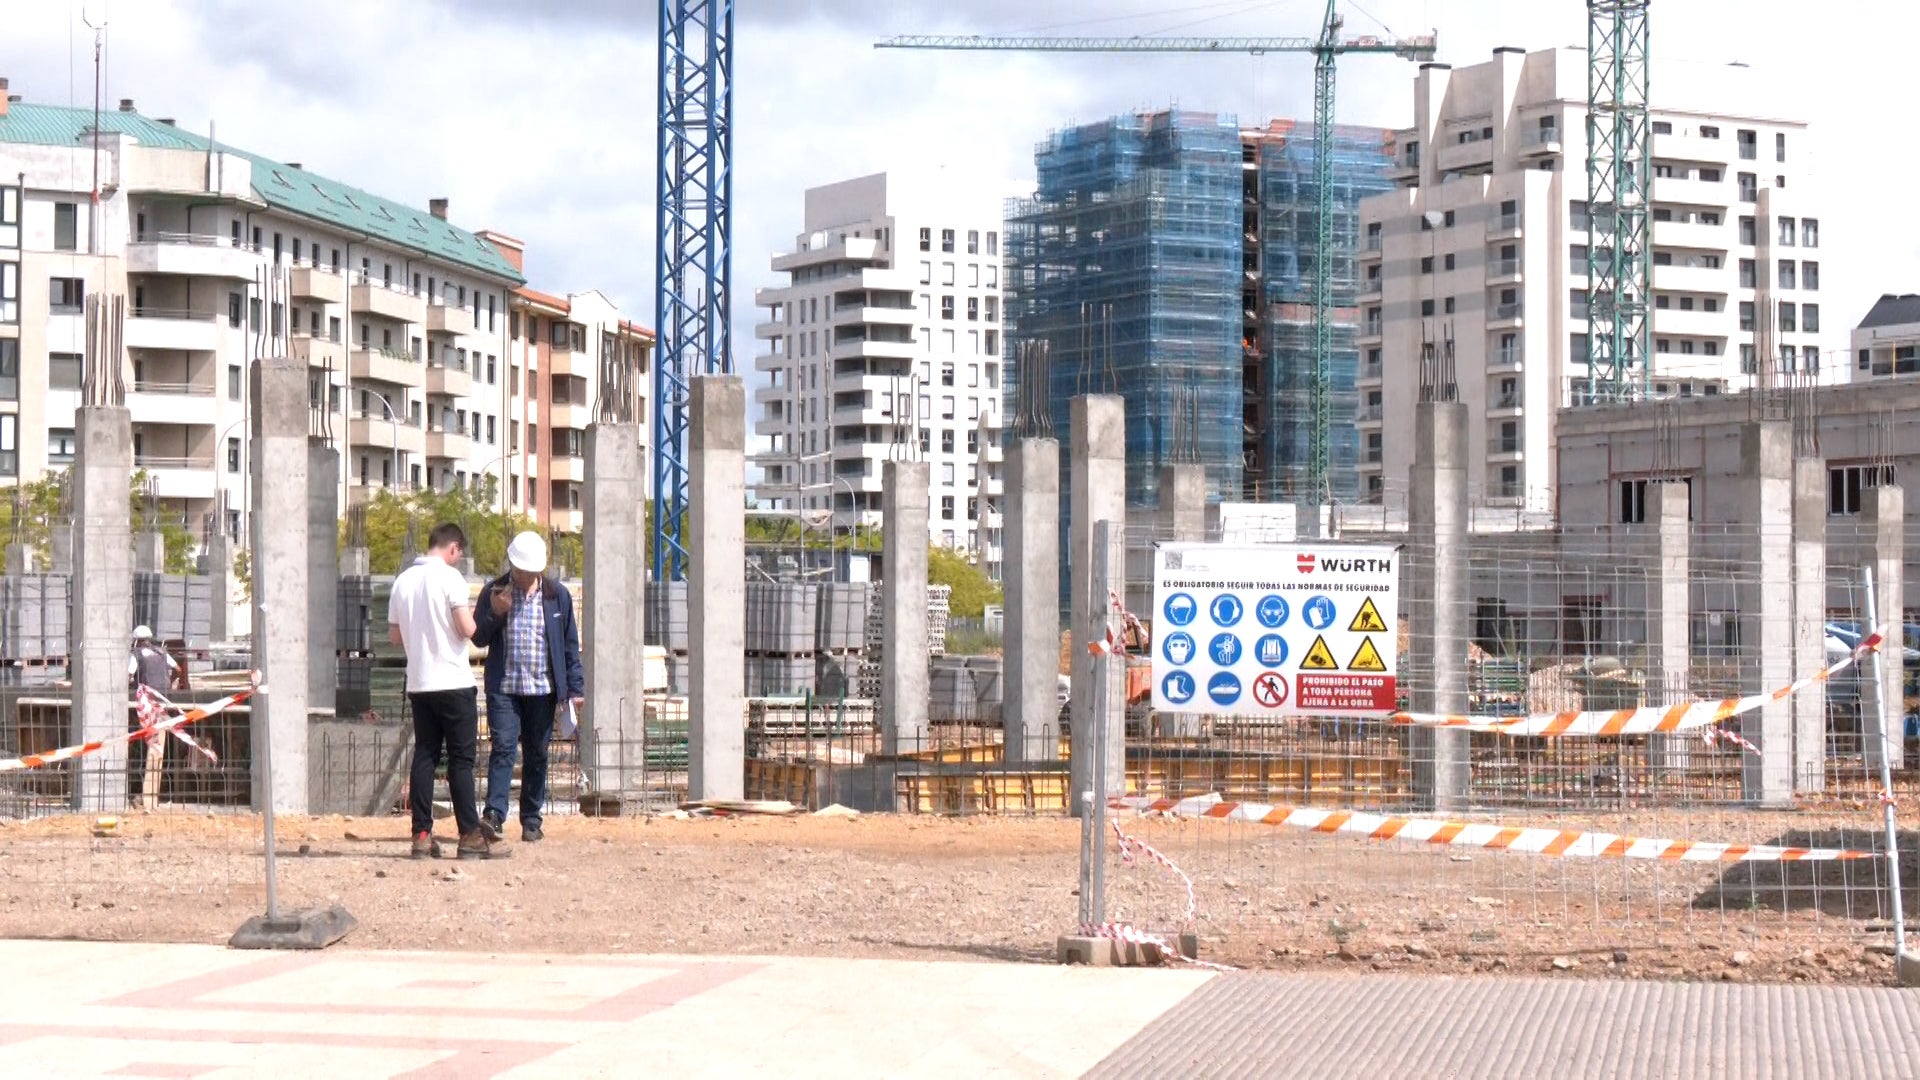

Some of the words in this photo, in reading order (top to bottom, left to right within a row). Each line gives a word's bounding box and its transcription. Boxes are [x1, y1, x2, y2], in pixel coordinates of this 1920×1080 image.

[1321, 559, 1391, 573] WÜRTH
[1163, 580, 1171, 588] ES
[1302, 677, 1349, 686] PROHIBIDO
[1351, 678, 1360, 686] EL
[1362, 678, 1384, 686] PASO
[1302, 687, 1308, 695] A
[1310, 687, 1332, 695] TODA
[1334, 688, 1372, 696] PERSONA
[1302, 697, 1328, 706] AJENA
[1330, 698, 1337, 706] A
[1338, 698, 1348, 706] LA
[1350, 699, 1374, 707] OBRA
